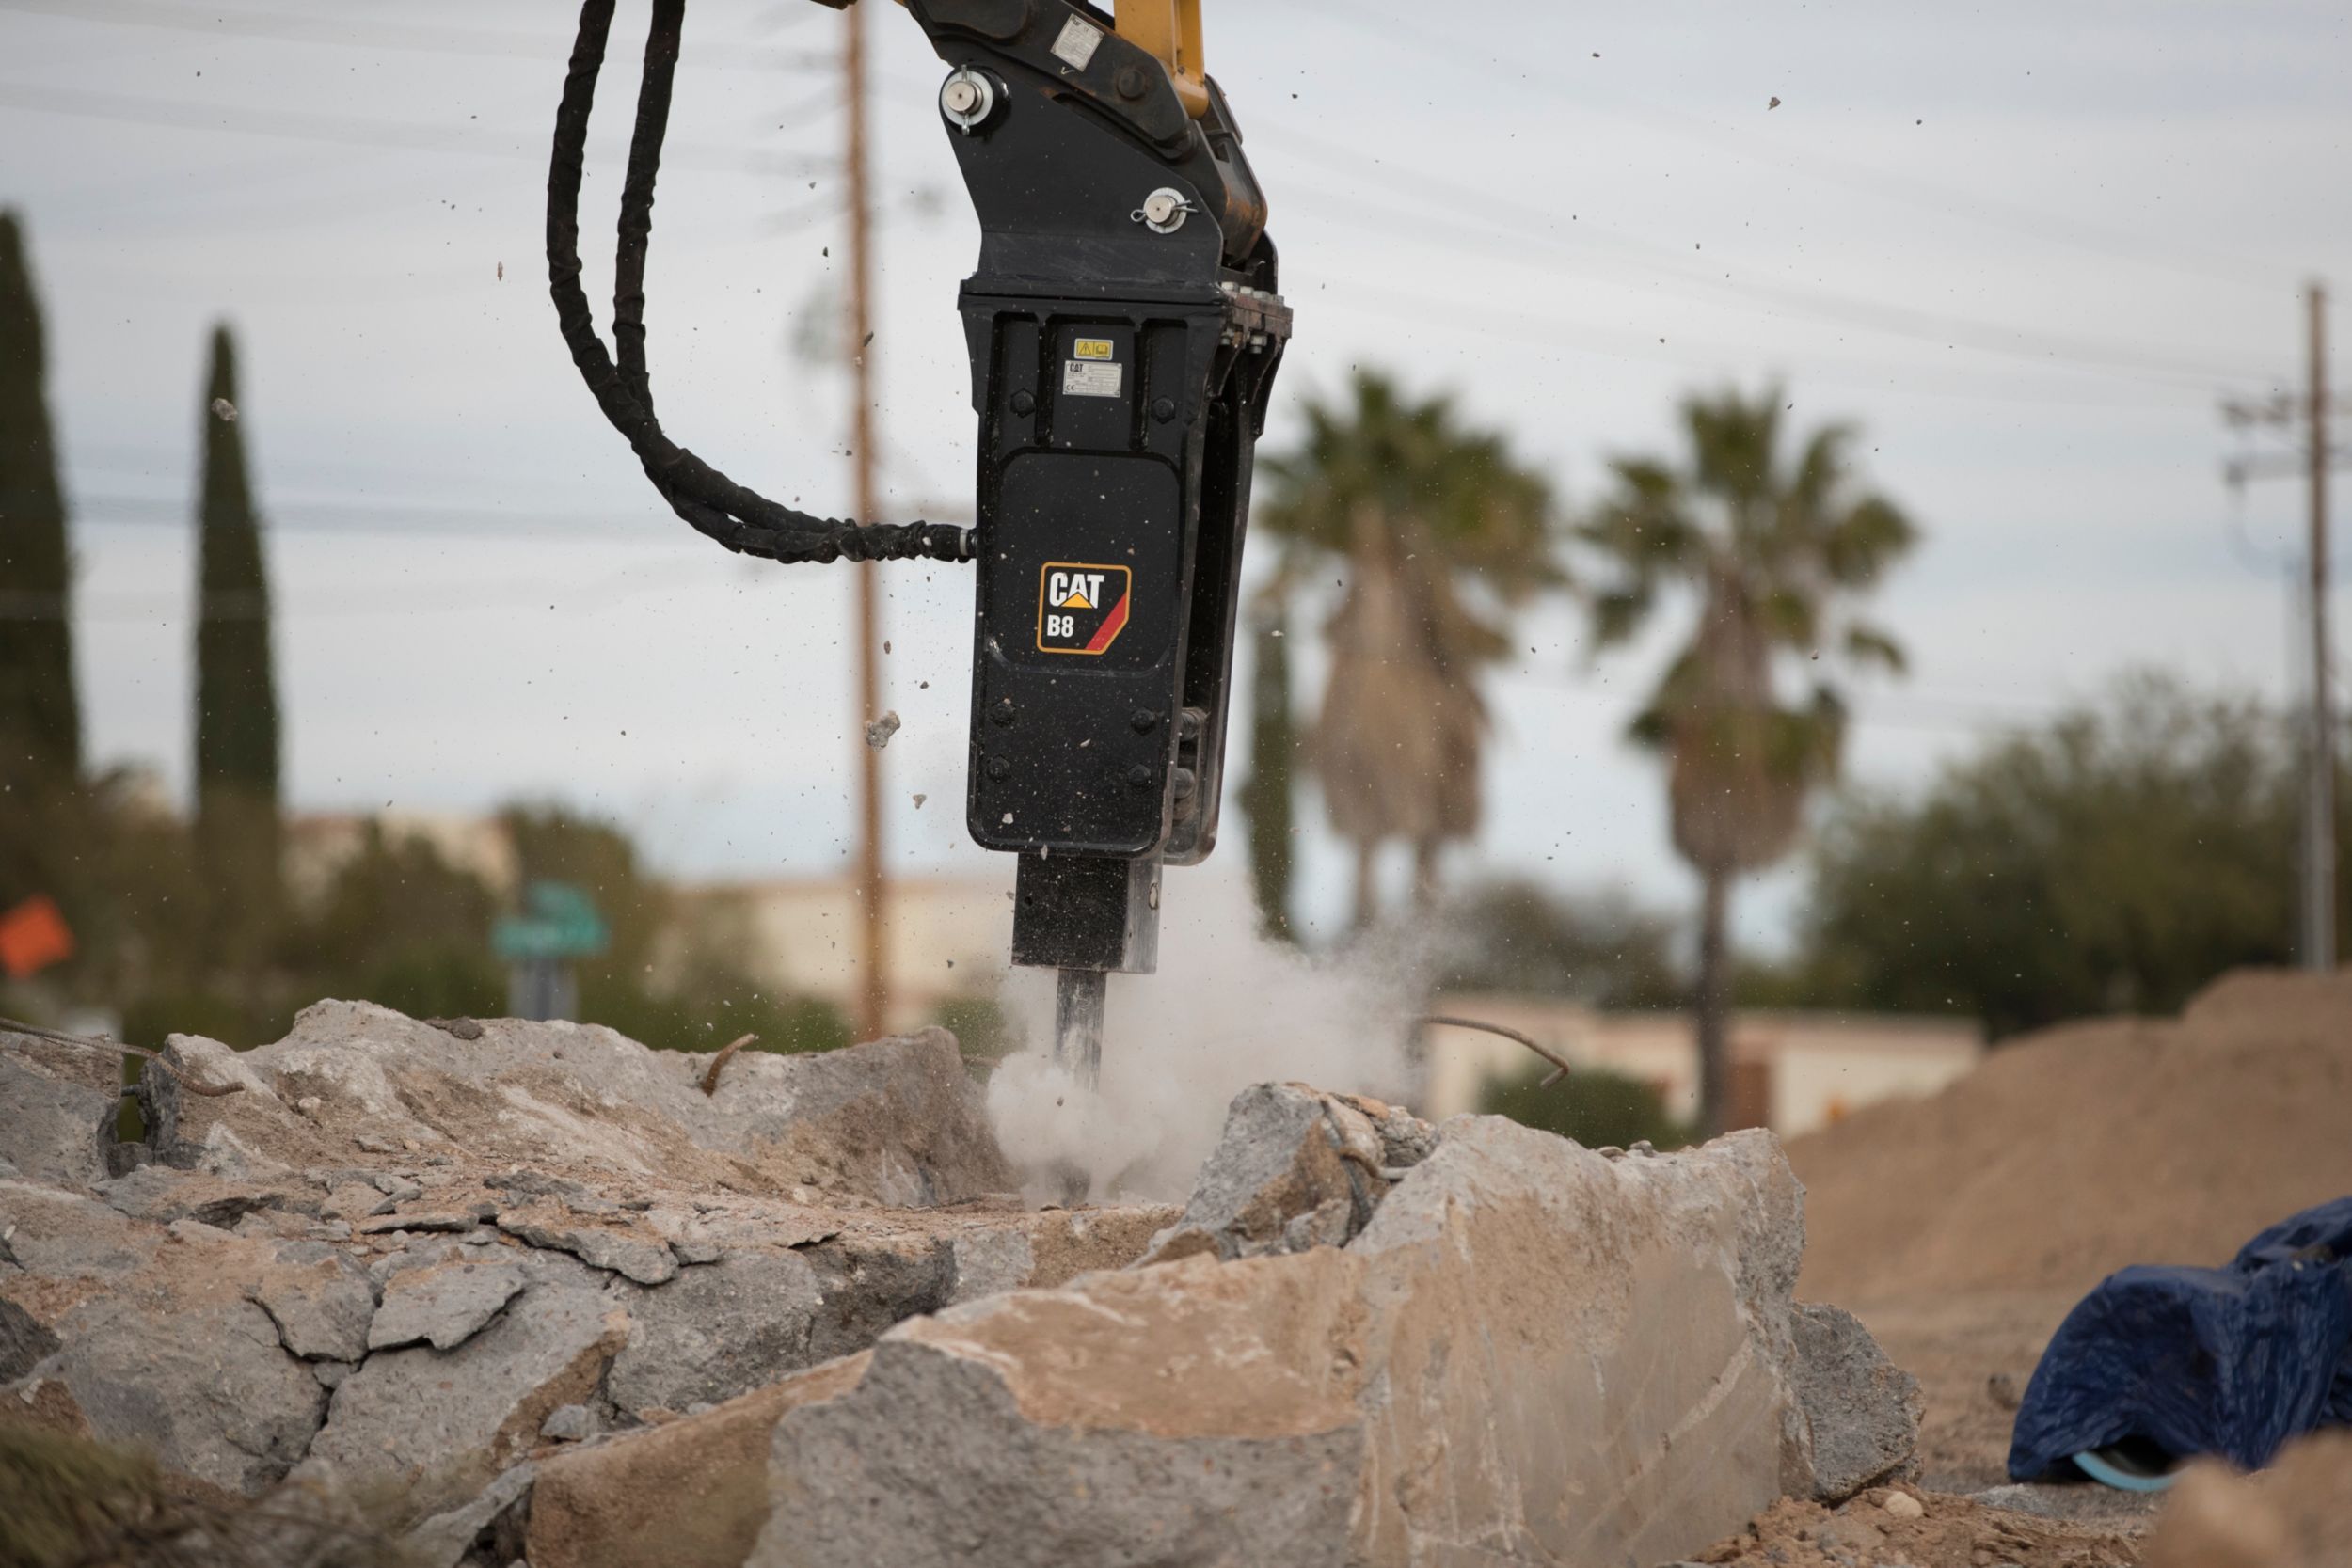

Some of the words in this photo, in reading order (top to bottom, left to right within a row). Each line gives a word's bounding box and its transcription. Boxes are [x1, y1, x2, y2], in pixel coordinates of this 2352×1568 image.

[1069, 363, 1084, 372] CAT
[1049, 572, 1104, 610] CAT
[1047, 615, 1074, 638] B8
